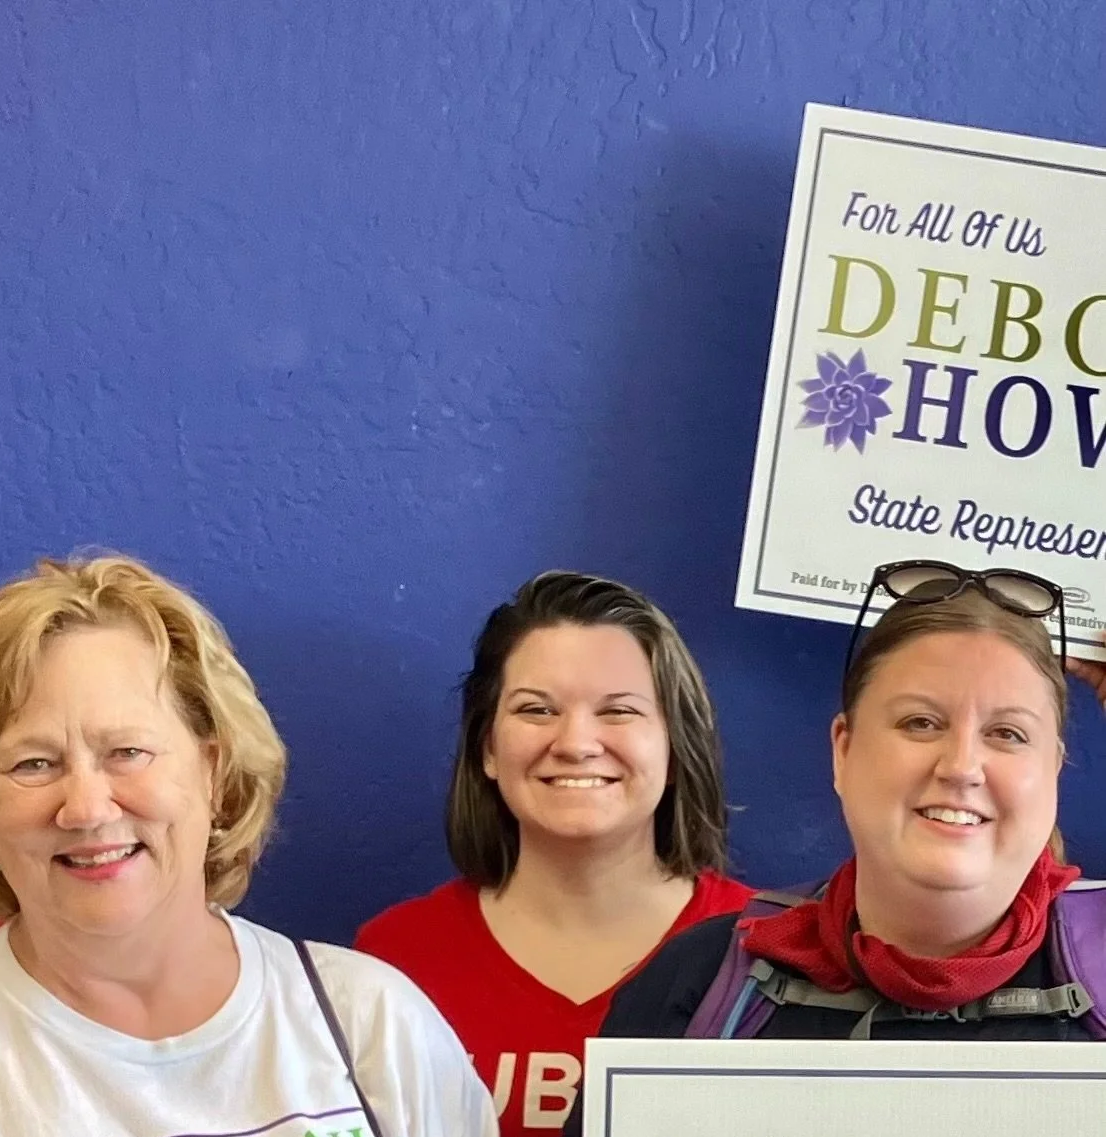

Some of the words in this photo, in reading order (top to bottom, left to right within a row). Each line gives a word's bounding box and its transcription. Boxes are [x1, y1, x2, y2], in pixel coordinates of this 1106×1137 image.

[842, 191, 900, 235] For
[906, 202, 956, 243] All
[961, 210, 1005, 249] Of
[1004, 217, 1048, 257] Us
[848, 484, 942, 535] State
[790, 571, 819, 587] Paid
[821, 576, 840, 590] for
[842, 579, 858, 595] by
